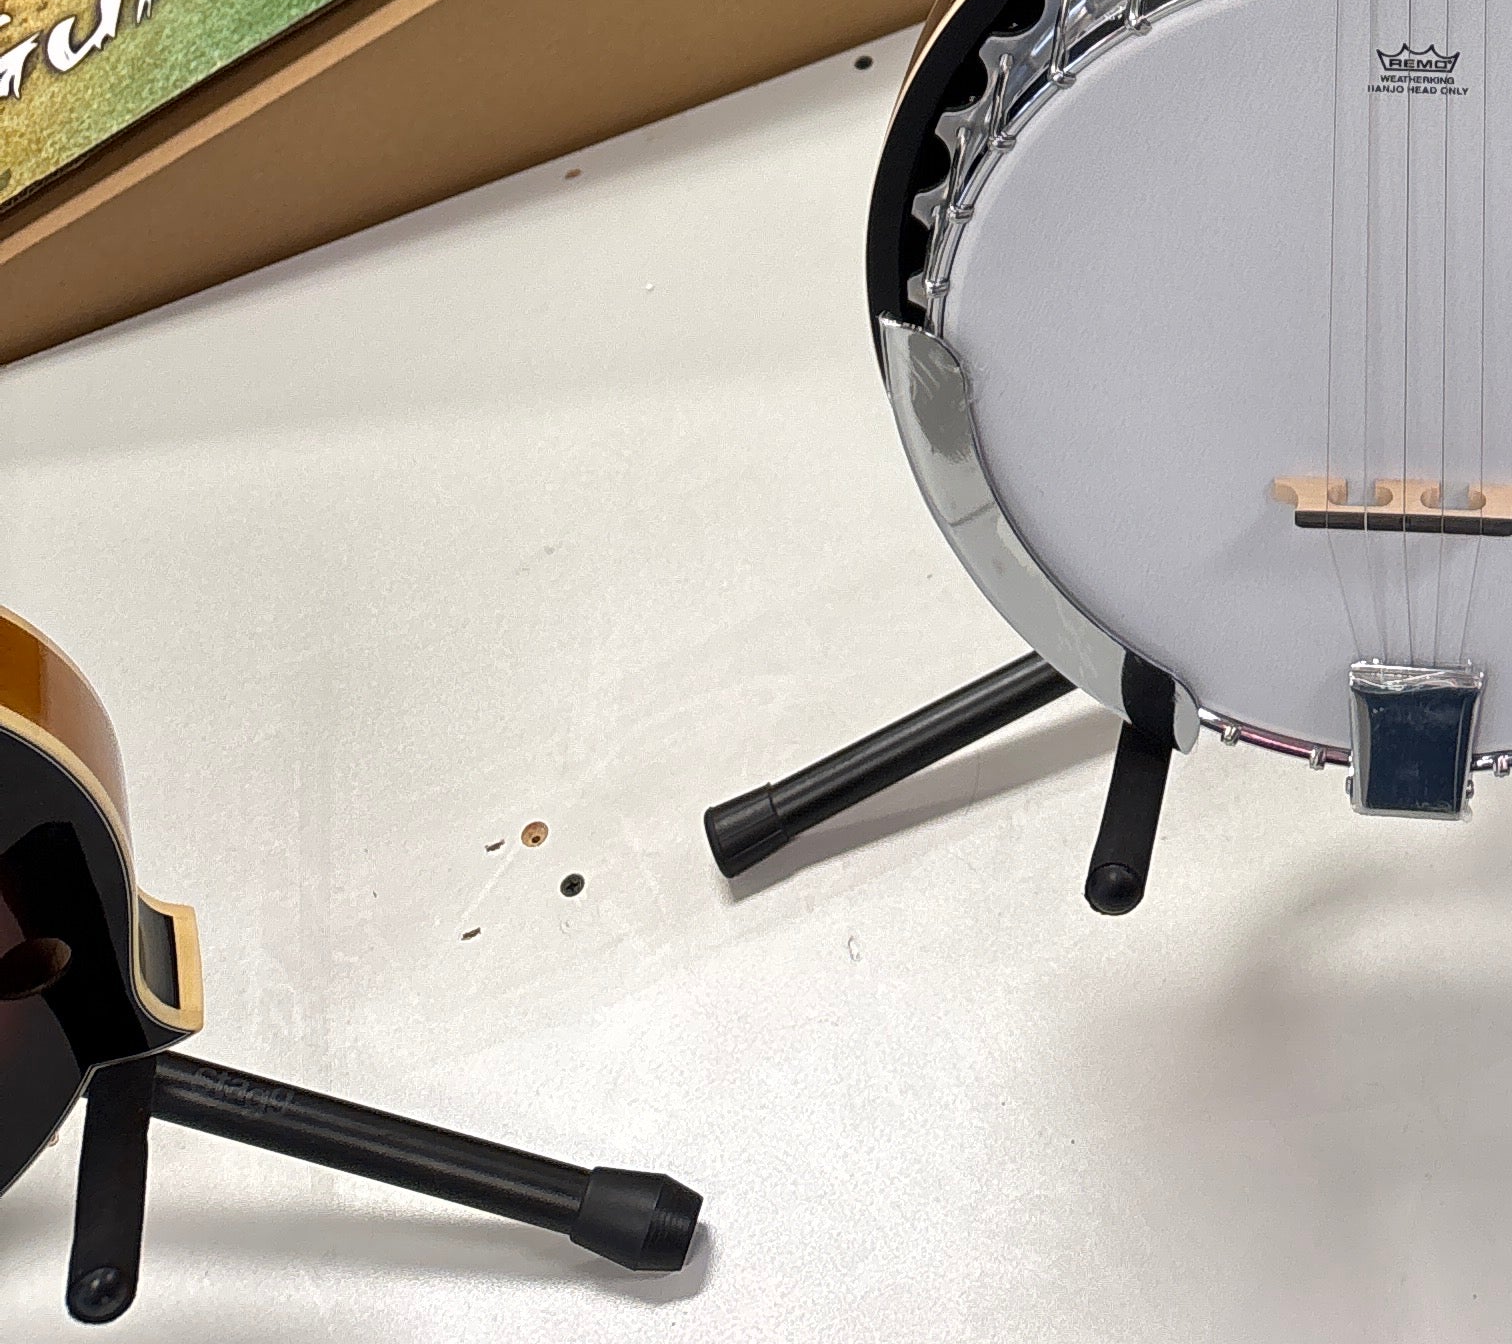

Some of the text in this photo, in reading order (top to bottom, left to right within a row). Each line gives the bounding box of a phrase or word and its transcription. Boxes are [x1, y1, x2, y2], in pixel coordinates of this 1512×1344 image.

[1389, 58, 1449, 70] REMO
[1380, 74, 1455, 85] WEATHERKING
[1407, 85, 1438, 95] HEAD
[1440, 86, 1469, 96] ONLY
